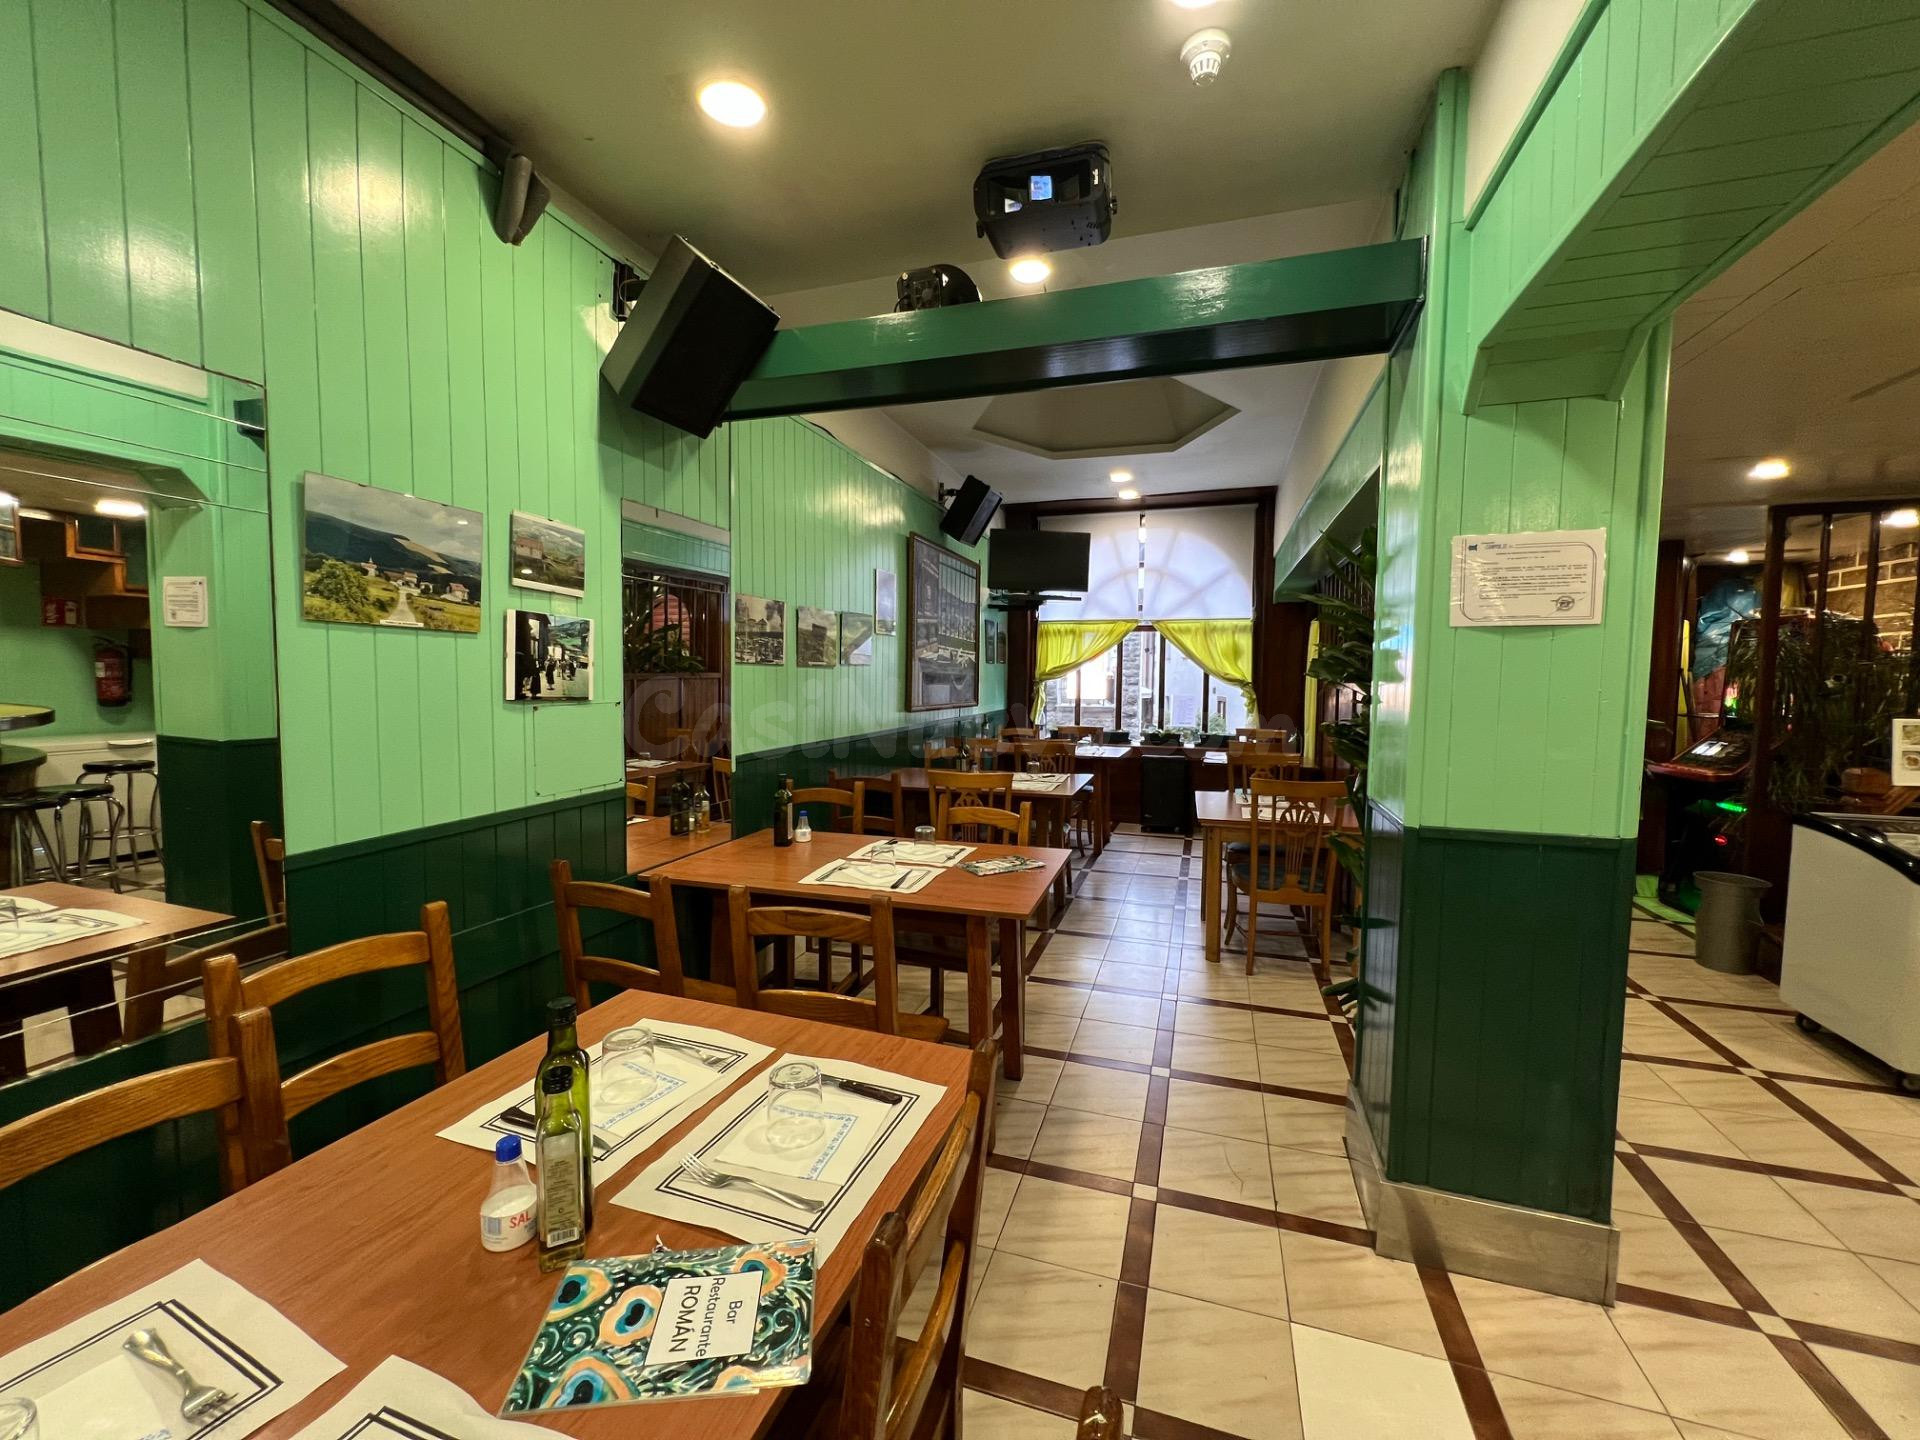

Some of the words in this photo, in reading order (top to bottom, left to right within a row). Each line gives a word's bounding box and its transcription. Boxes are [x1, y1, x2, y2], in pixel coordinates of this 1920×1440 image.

[509, 1212, 532, 1229] SAL
[668, 1285, 702, 1353] ROMÁN
[695, 1277, 726, 1357] Restaurante
[726, 1300, 743, 1324] Bar
